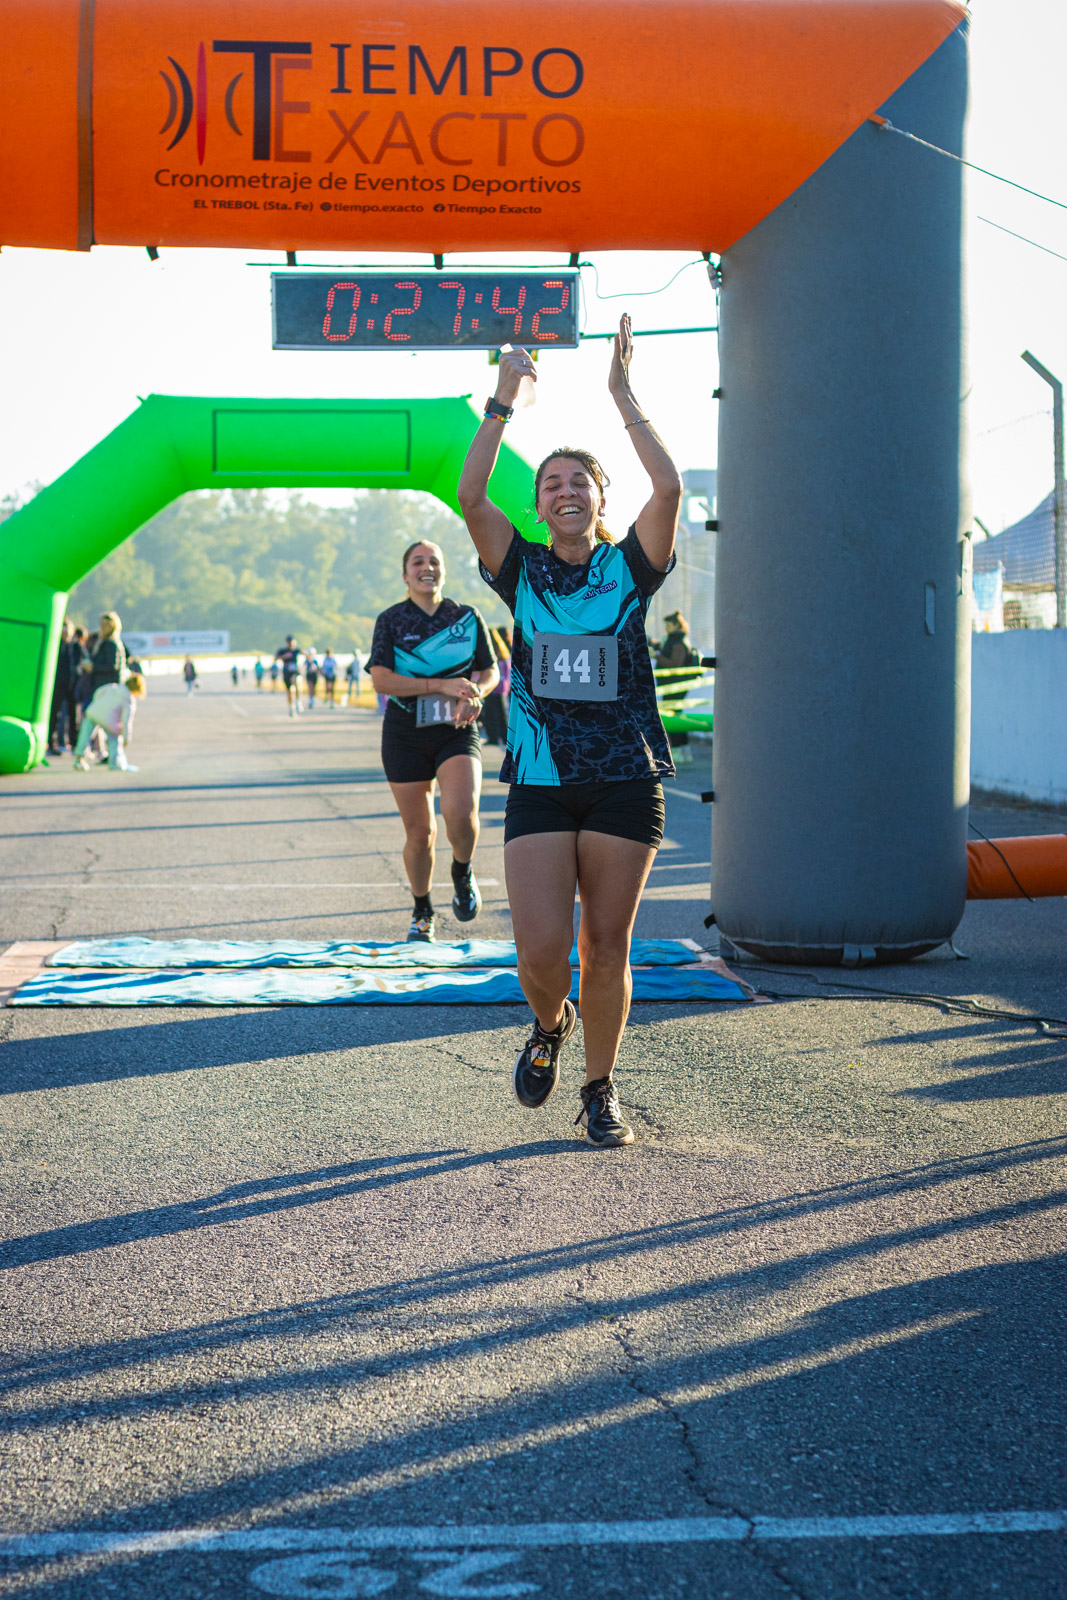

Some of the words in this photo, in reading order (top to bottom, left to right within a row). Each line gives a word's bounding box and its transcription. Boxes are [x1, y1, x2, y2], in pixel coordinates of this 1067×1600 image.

[154, 168, 313, 194] Cronometraje
[318, 171, 348, 191] de
[354, 173, 446, 192] Eventos
[452, 174, 582, 197] Deportivos
[193, 199, 208, 209] EL
[211, 199, 260, 210] TREBOL
[263, 200, 292, 211] (Sta.
[294, 201, 314, 212] Fe)
[334, 201, 425, 214] tiempo.exacto
[448, 203, 497, 215] Tiempo
[499, 204, 542, 215] Exacto
[322, 281, 570, 342] 0:27:42
[540, 644, 549, 685] TIEMPO
[553, 648, 591, 683] 44
[598, 647, 606, 687] EXACTO
[433, 700, 452, 721] 11
